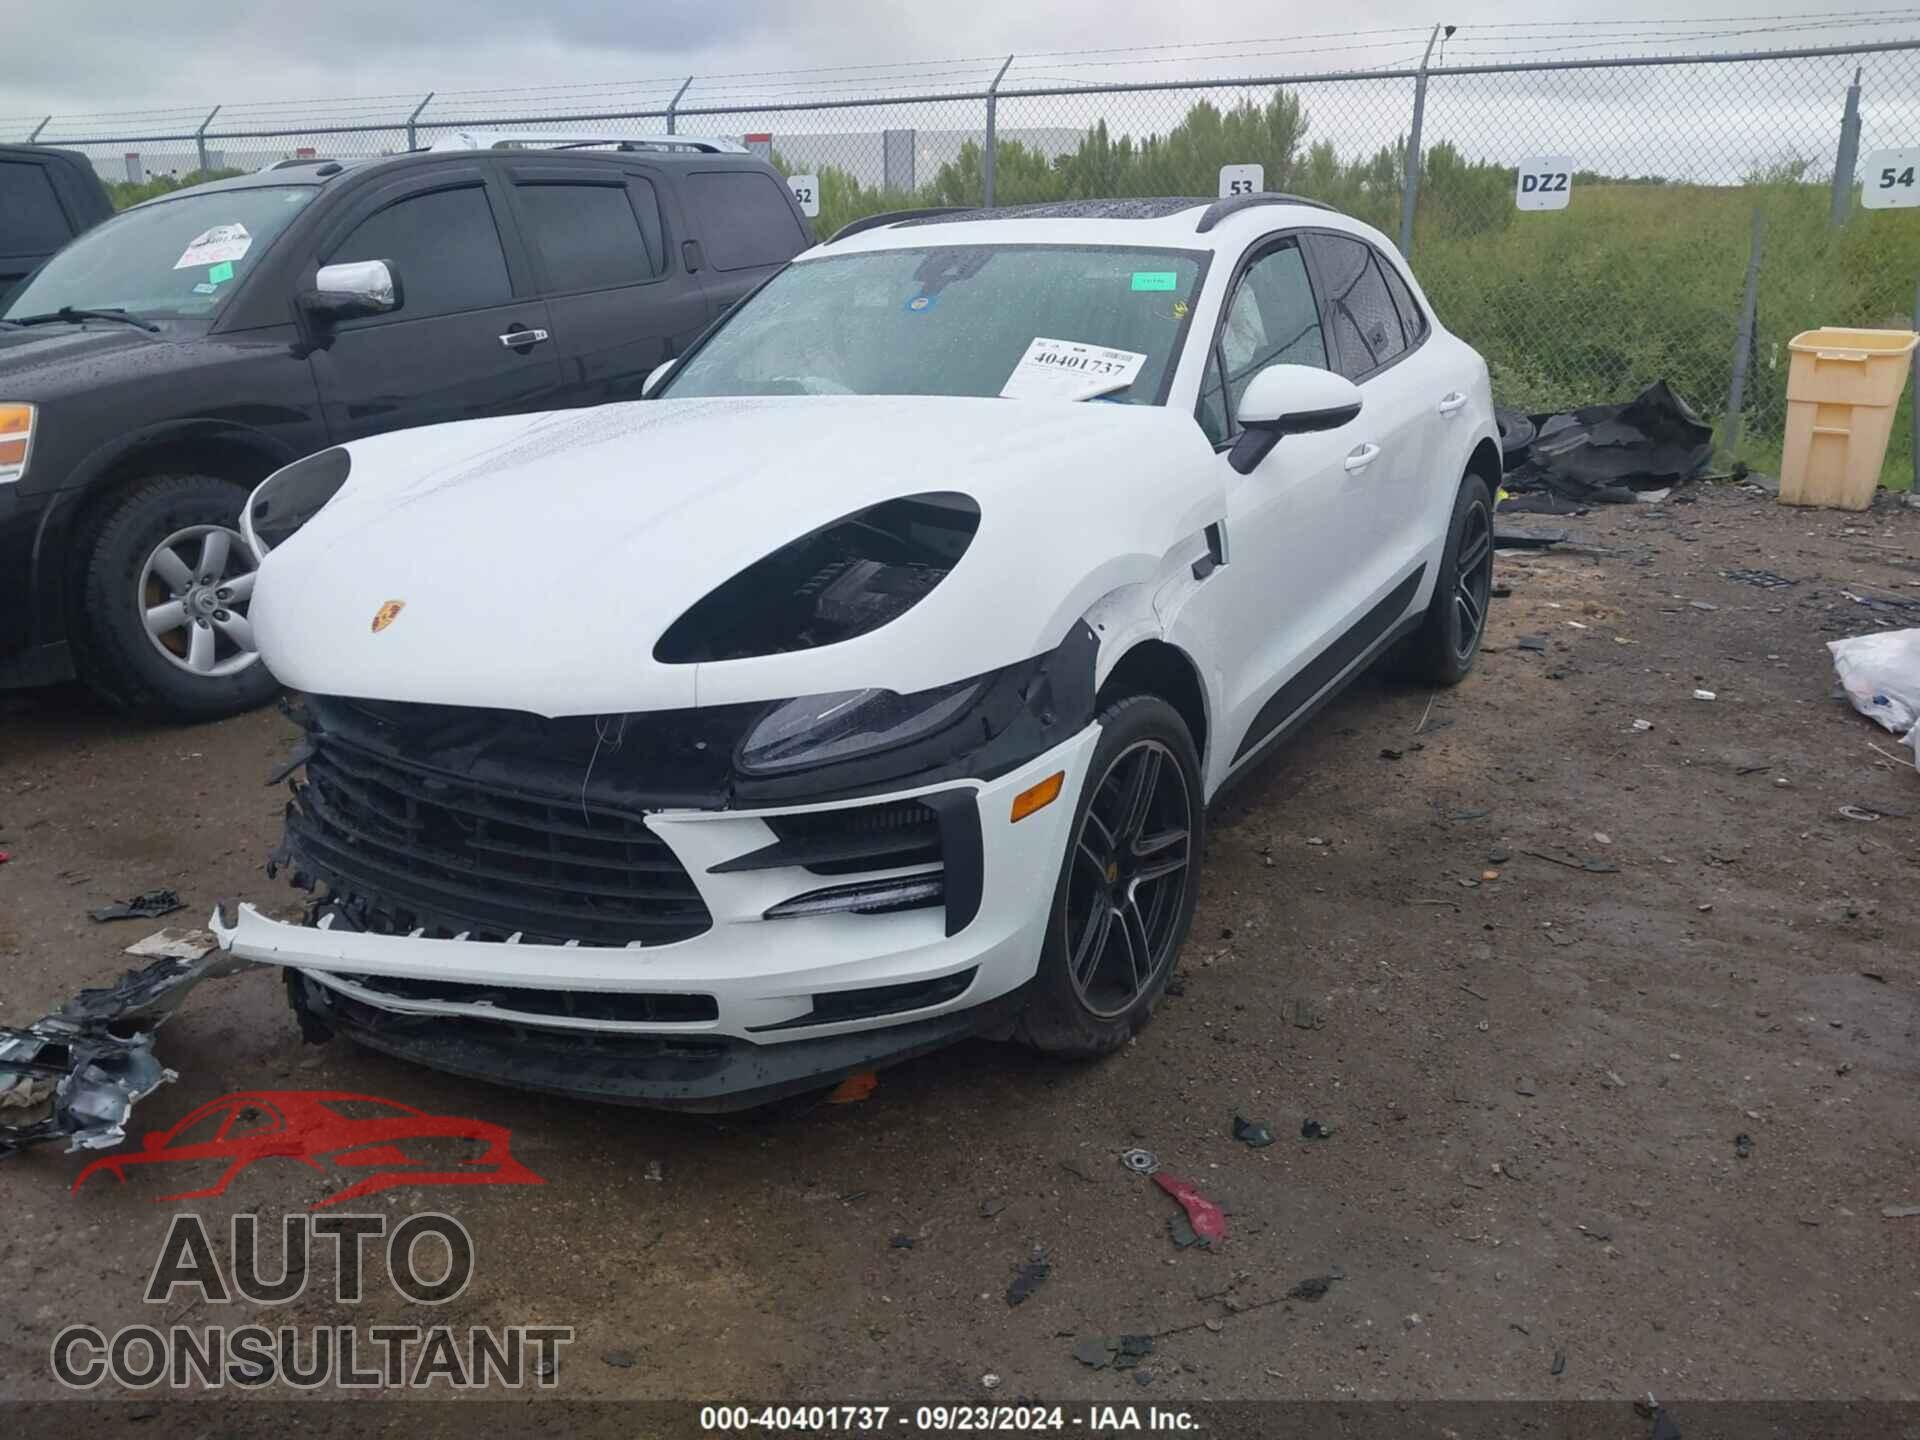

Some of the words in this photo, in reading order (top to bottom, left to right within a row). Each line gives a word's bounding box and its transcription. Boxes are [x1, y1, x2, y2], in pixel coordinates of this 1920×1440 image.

[1522, 172, 1568, 192] DZ2
[1879, 166, 1914, 188] 54
[795, 188, 811, 203] 52
[1230, 180, 1253, 195] 53
[1034, 351, 1125, 377] 40401737
